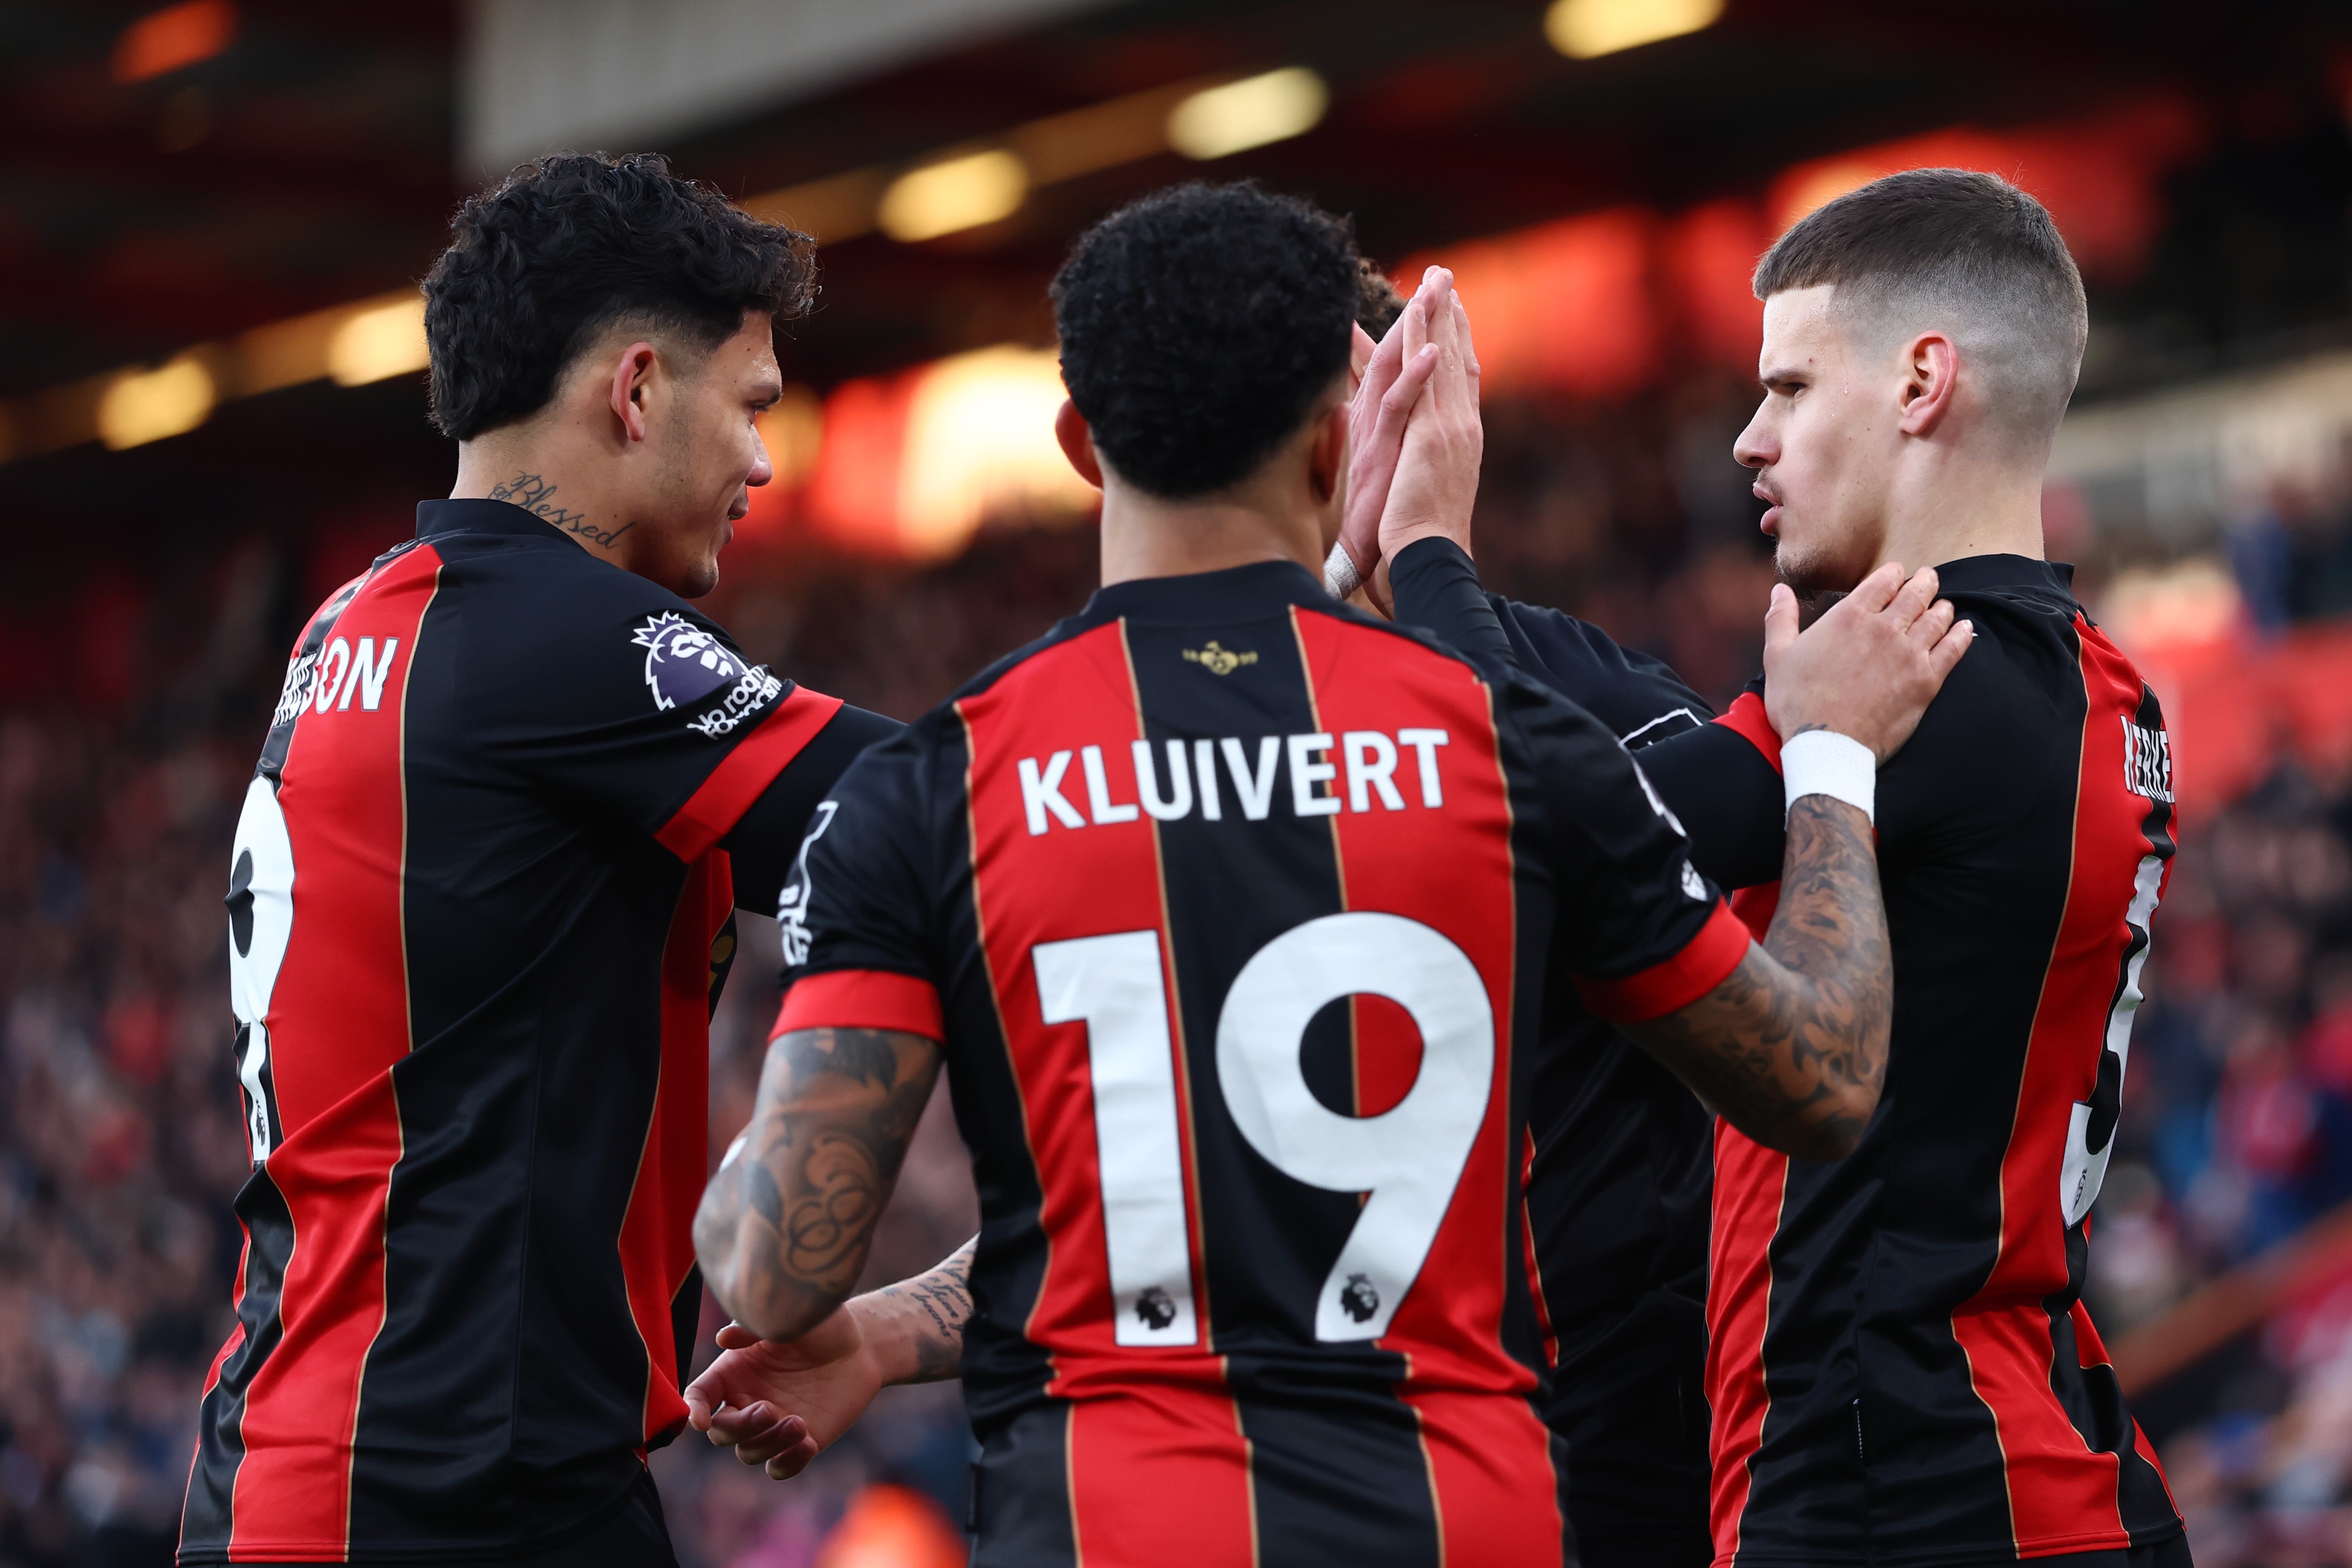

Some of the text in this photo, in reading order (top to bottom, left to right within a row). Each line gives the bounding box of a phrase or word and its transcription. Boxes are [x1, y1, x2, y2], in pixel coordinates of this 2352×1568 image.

[488, 470, 637, 549] Blessed
[723, 666, 765, 714] room
[1018, 728, 1449, 836] KLUIVERT
[2120, 714, 2175, 804] KERKE
[1032, 911, 1495, 1346] 19
